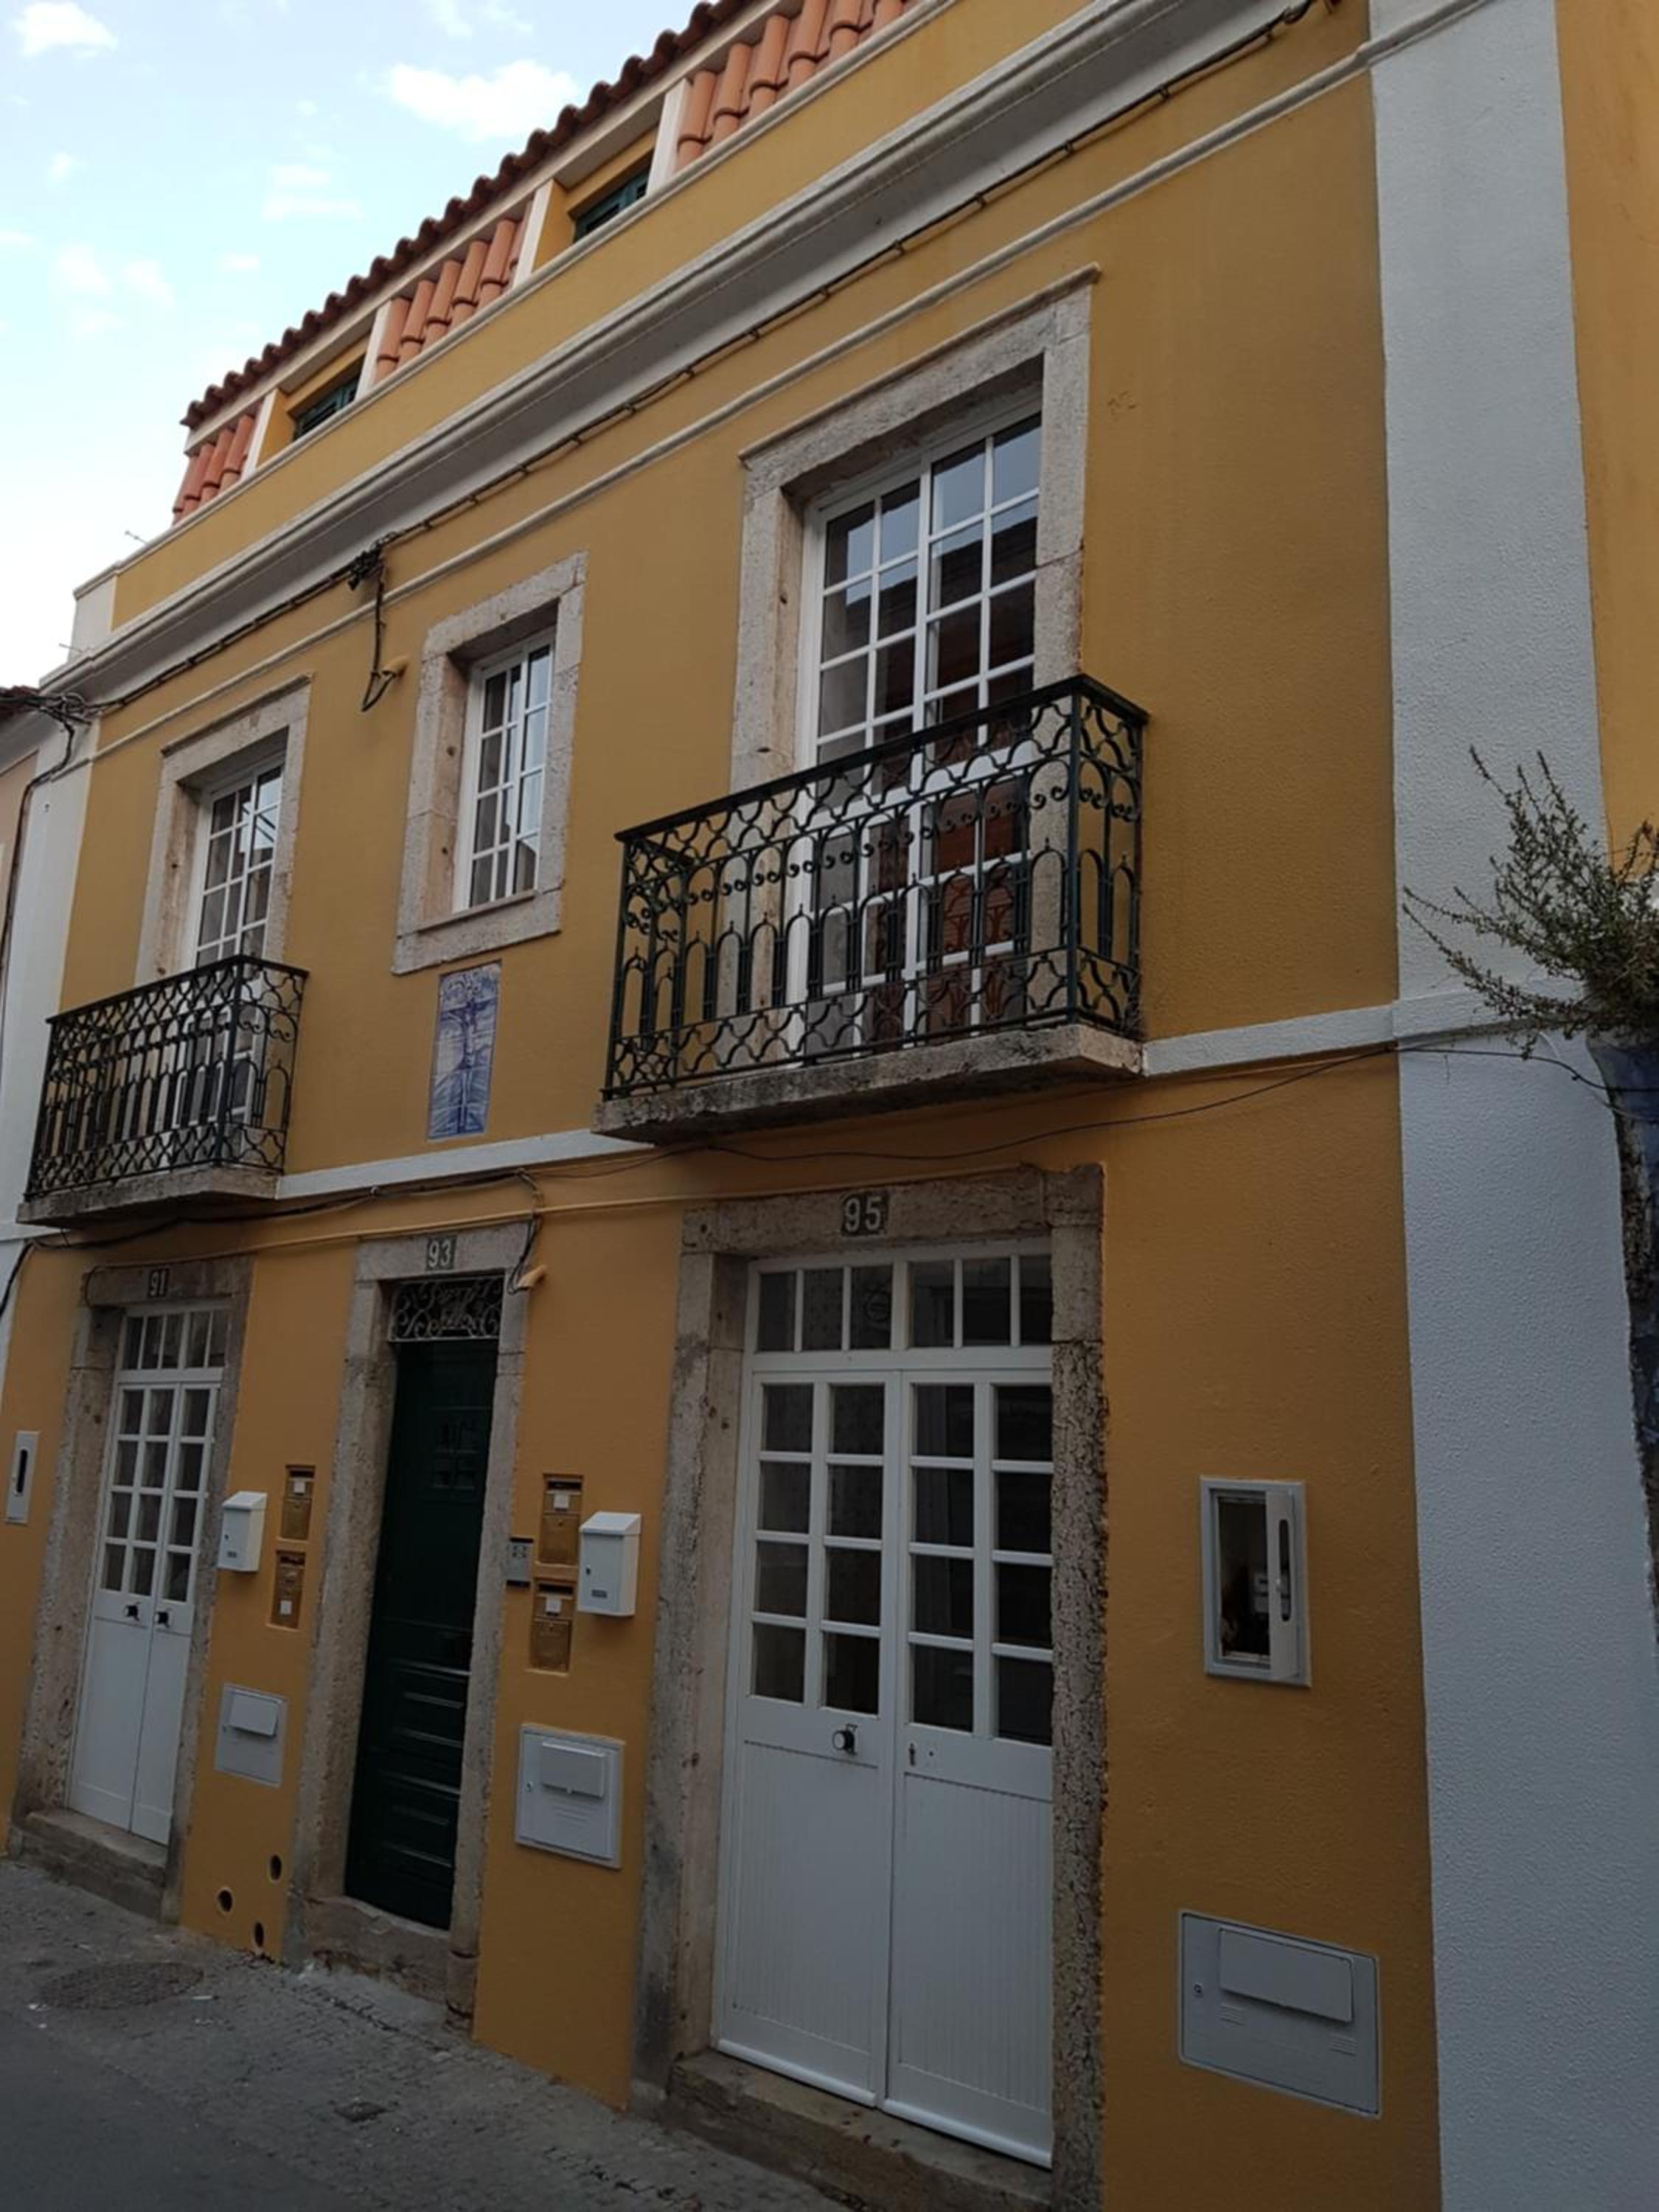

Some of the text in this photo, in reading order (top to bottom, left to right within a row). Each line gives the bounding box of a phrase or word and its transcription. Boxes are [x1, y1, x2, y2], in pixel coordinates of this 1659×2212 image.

[845, 1196, 882, 1232] 95
[428, 1239, 451, 1267] 93
[150, 1270, 166, 1295] 91
